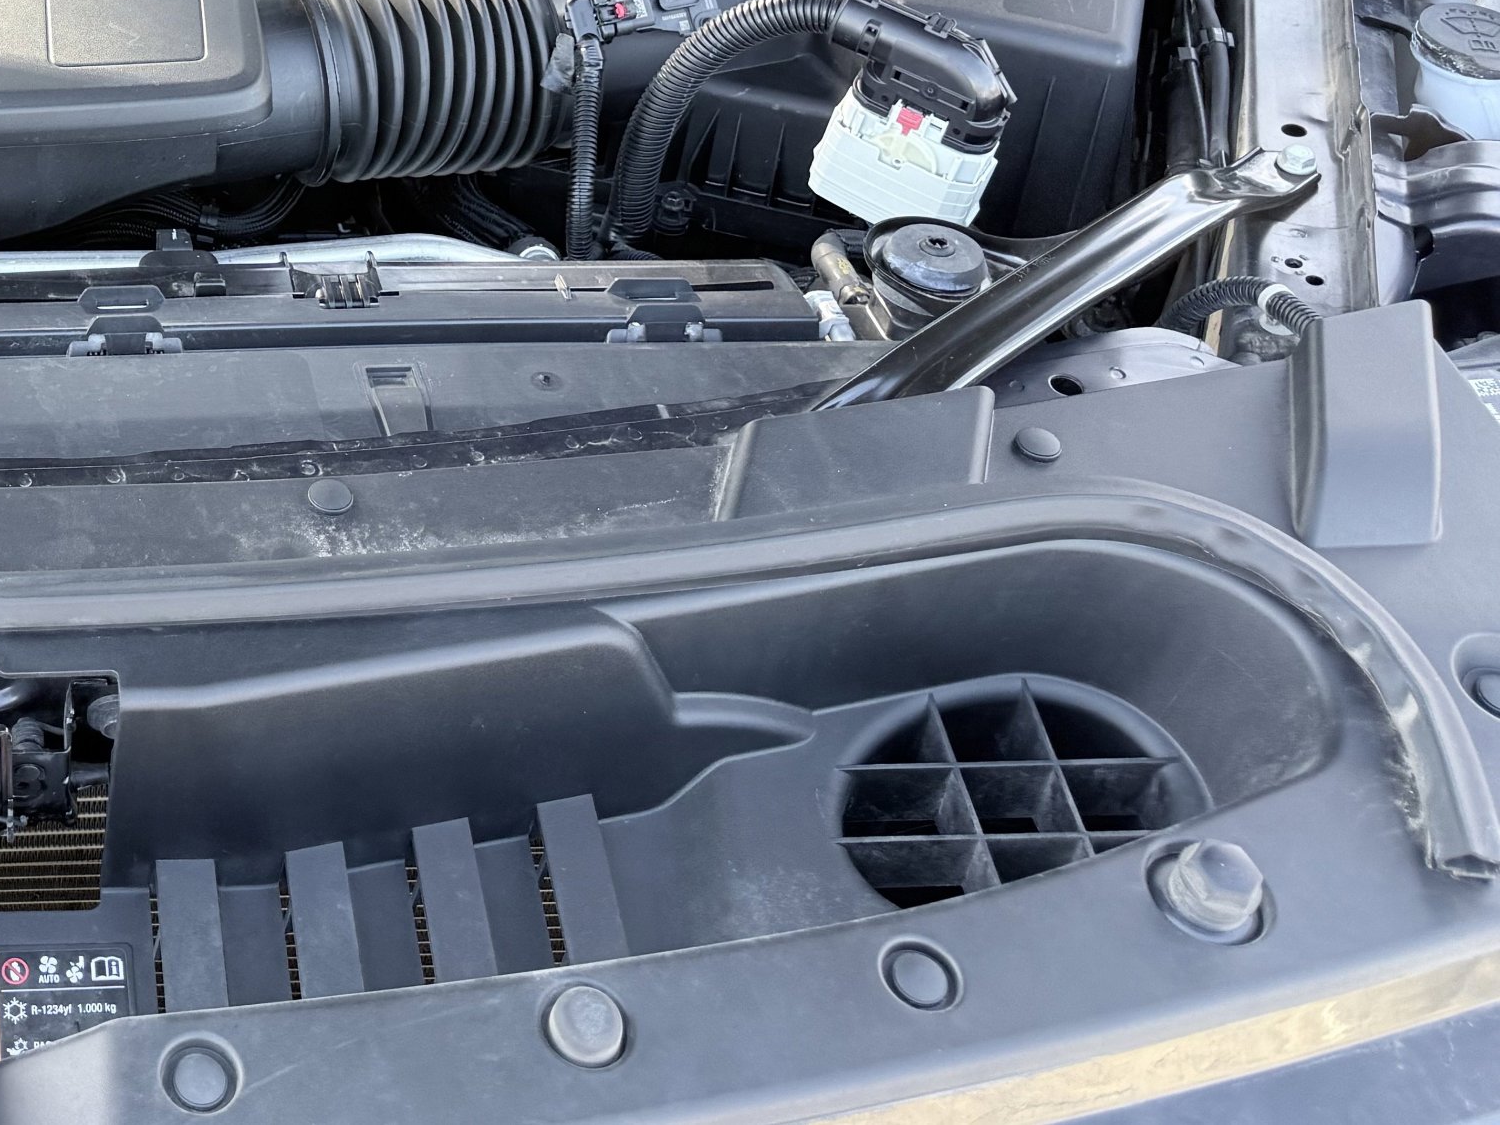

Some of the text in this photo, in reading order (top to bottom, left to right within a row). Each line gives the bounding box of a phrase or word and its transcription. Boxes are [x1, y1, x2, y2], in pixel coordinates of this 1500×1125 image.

[38, 974, 60, 984] AUTO
[31, 1002, 117, 1016] R-1234yf 1.000 kg
